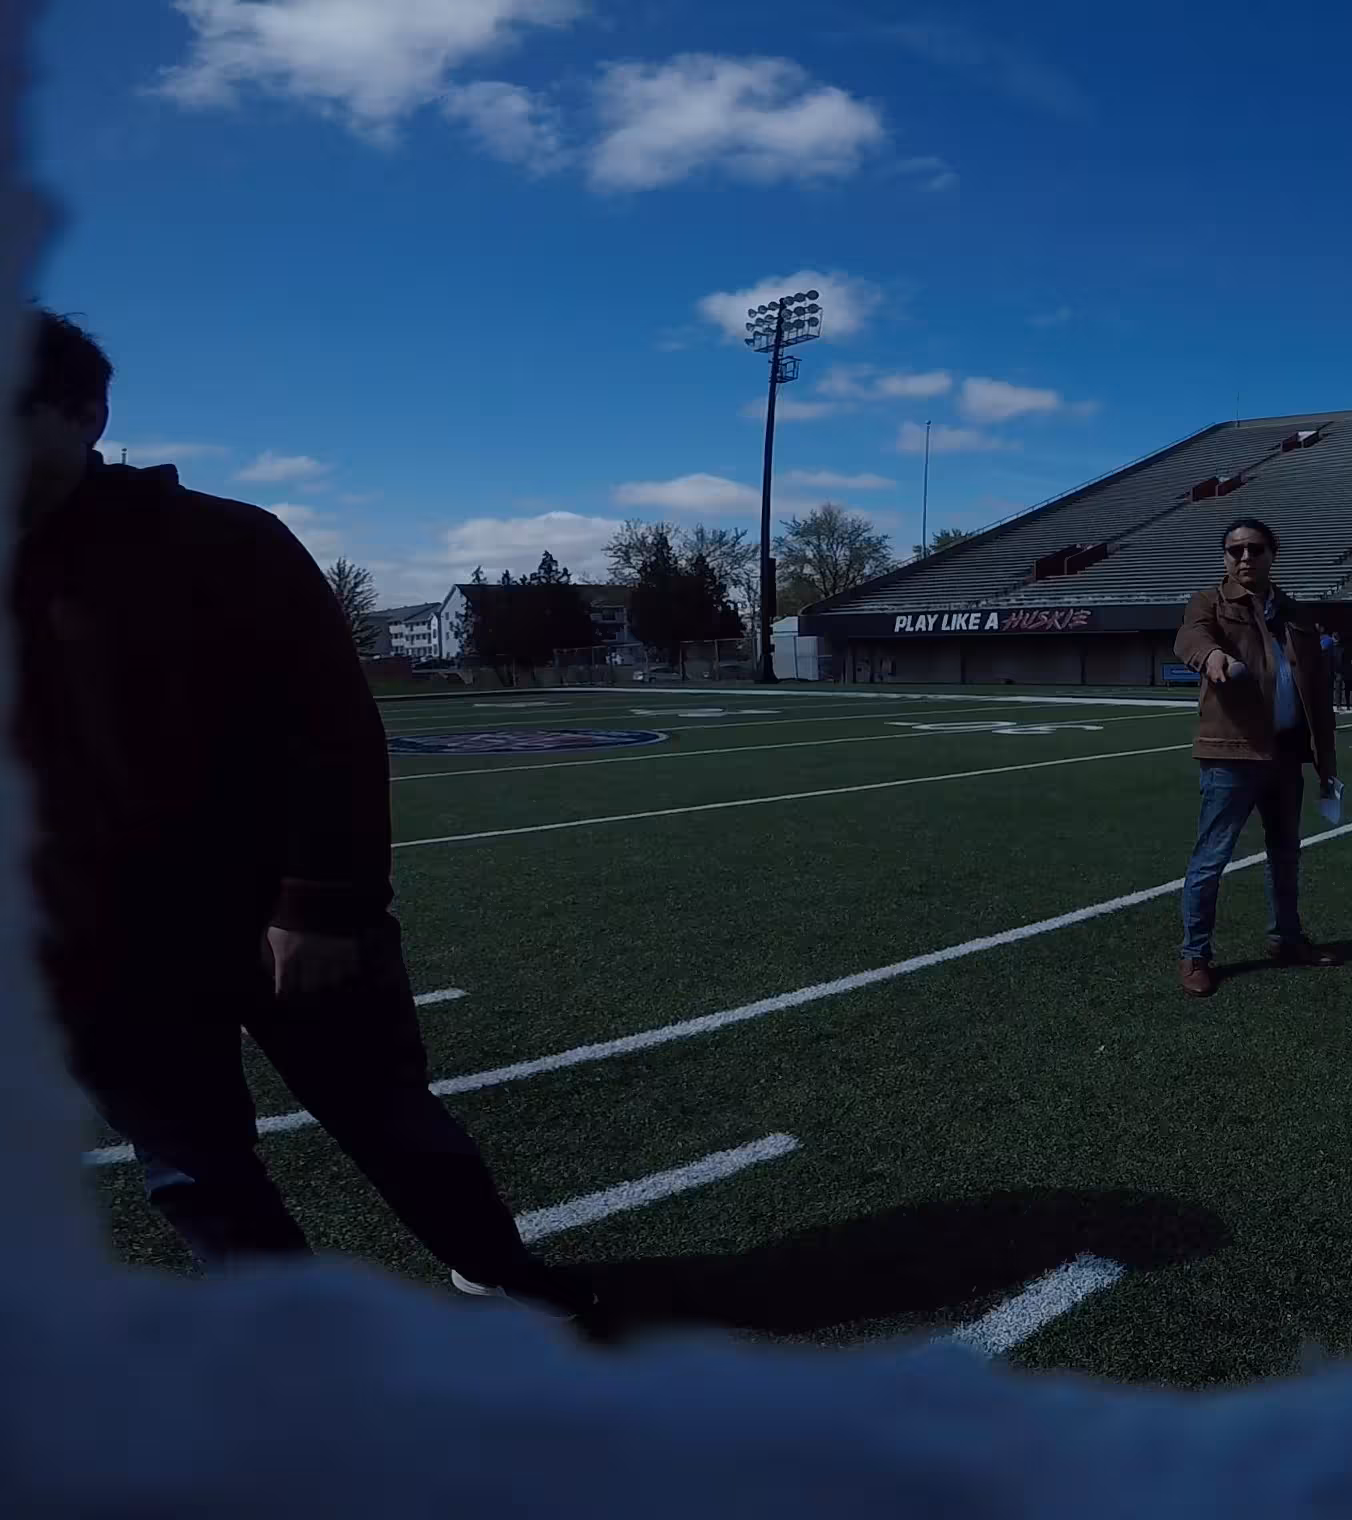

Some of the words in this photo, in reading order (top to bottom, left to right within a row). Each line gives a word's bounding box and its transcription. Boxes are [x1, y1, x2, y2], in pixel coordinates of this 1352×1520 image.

[894, 613, 939, 632] PLAY
[941, 612, 980, 631] LIKE
[984, 611, 999, 630] A
[1002, 608, 1092, 631] HUSKIE
